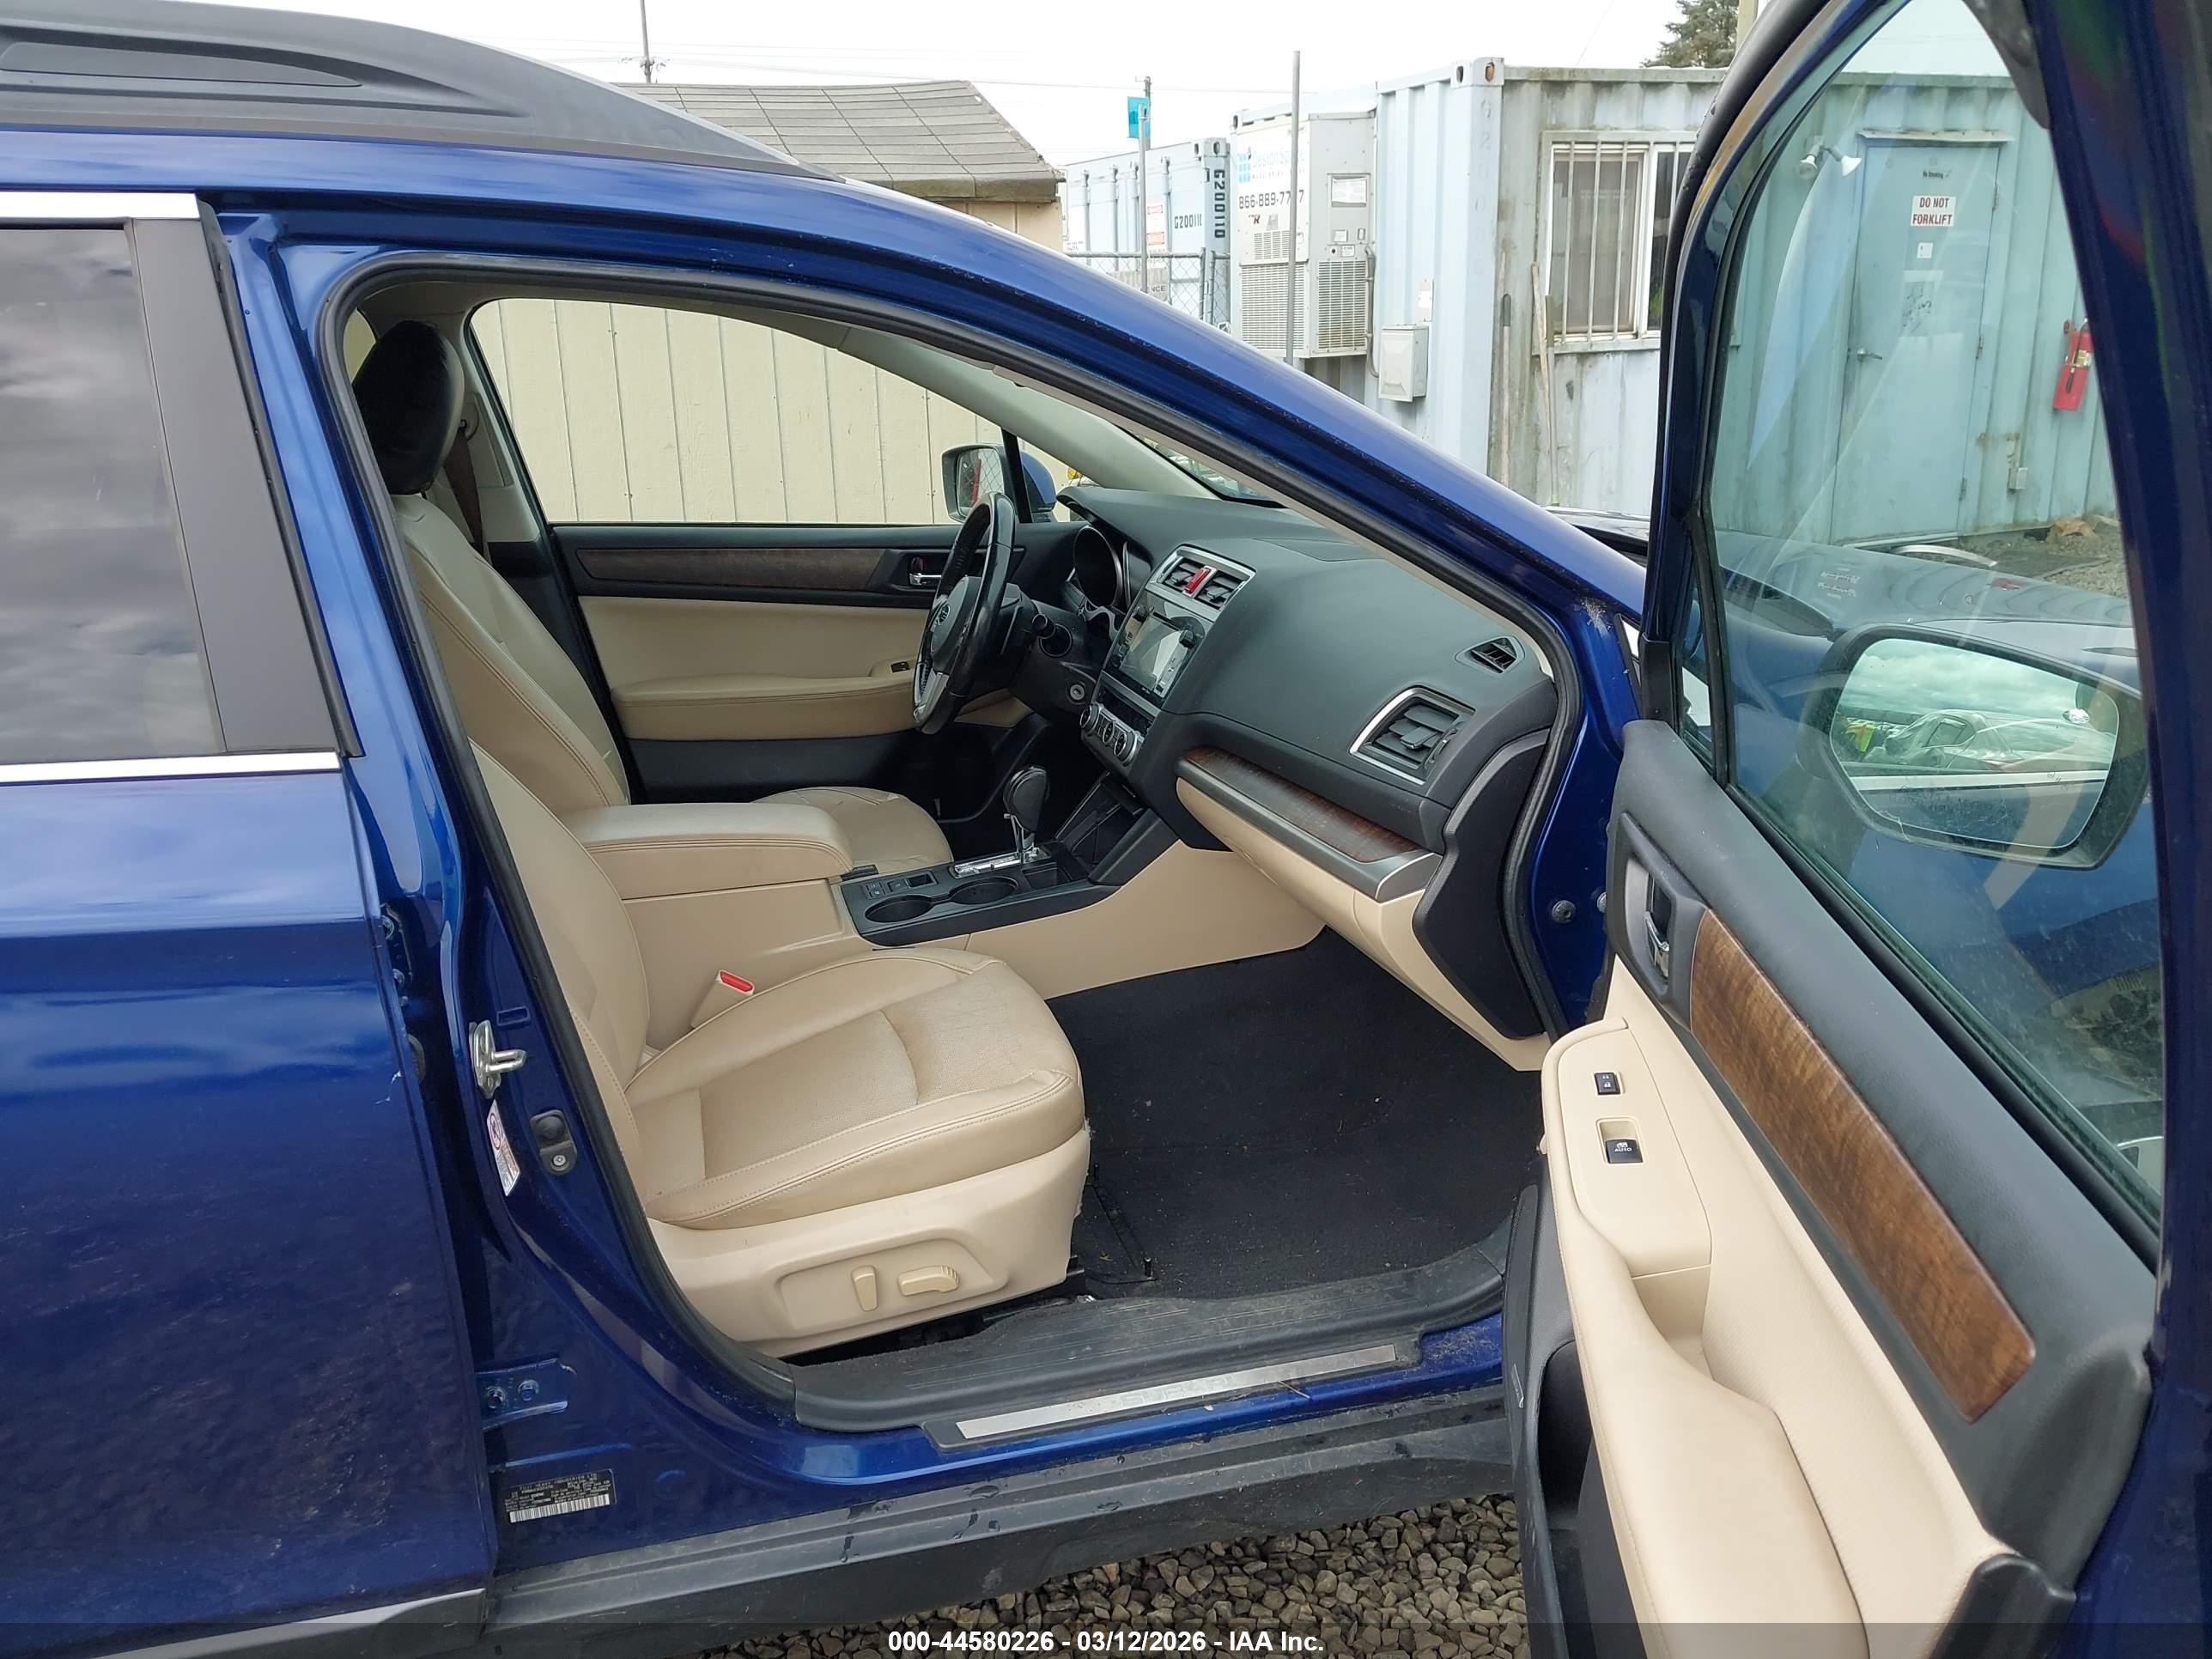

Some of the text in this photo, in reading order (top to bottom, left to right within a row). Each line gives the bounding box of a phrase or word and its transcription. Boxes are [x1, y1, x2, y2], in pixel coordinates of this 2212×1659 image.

[1213, 169, 1225, 239] G200110
[1919, 197, 1950, 208] DO NOT
[1912, 214, 1953, 225] FORKLIFT
